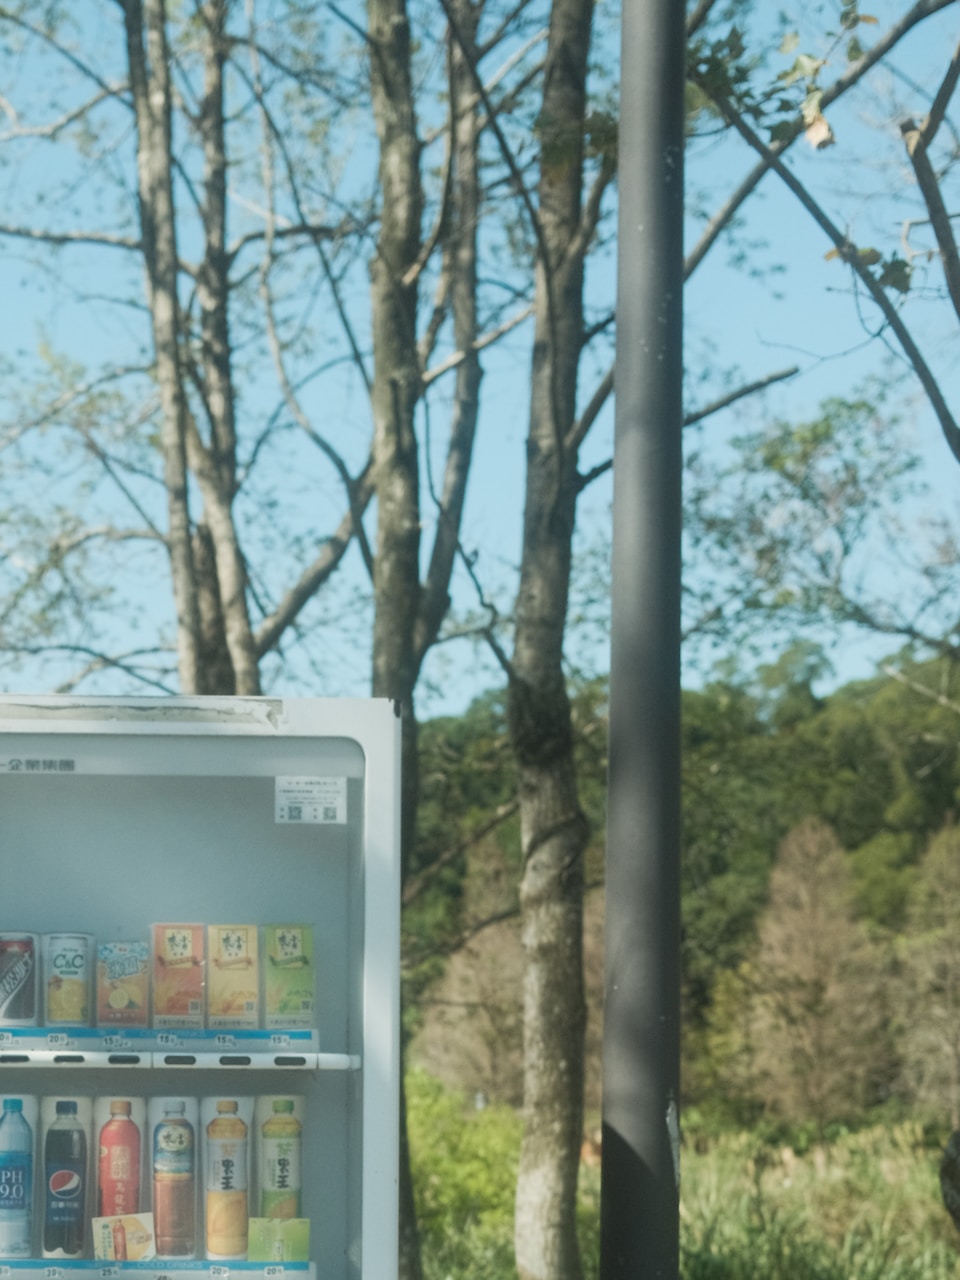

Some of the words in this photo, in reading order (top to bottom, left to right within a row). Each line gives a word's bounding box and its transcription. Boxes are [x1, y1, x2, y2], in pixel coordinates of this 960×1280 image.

[53, 954, 84, 969] C&C
[1, 1170, 23, 1183] PH
[0, 1184, 24, 1198] 9.0
[137, 1261, 168, 1269] COLD
